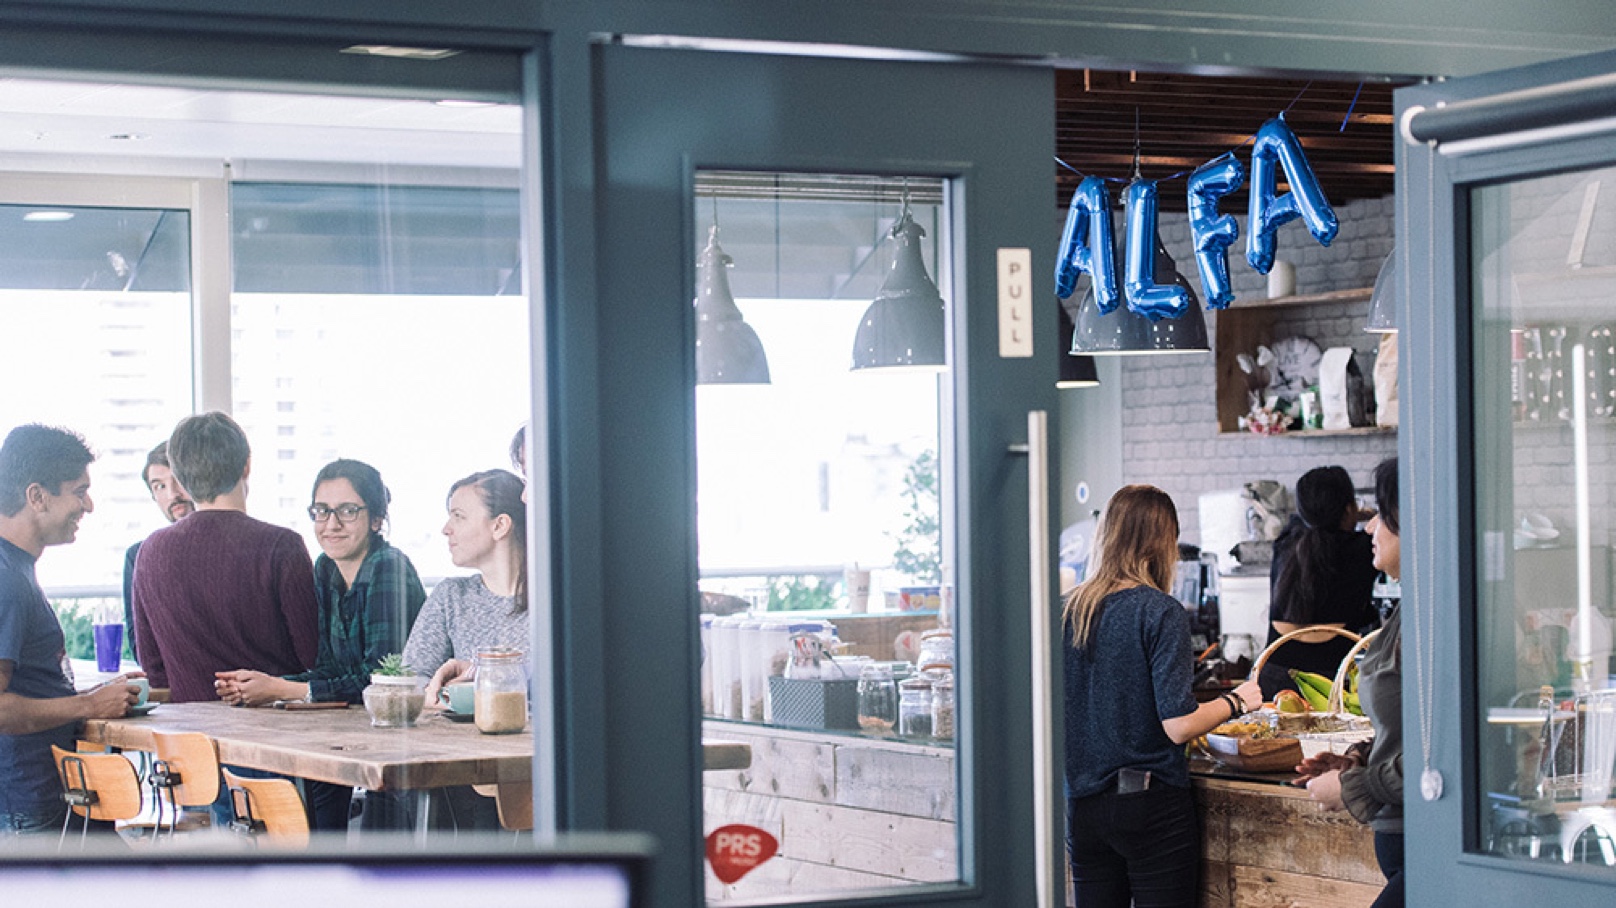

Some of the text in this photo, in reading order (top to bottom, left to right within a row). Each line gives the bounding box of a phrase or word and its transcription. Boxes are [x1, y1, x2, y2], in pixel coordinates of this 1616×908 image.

[1054, 117, 1339, 322] ALFA
[1009, 262, 1022, 343] PULL
[715, 832, 761, 856] PRS
